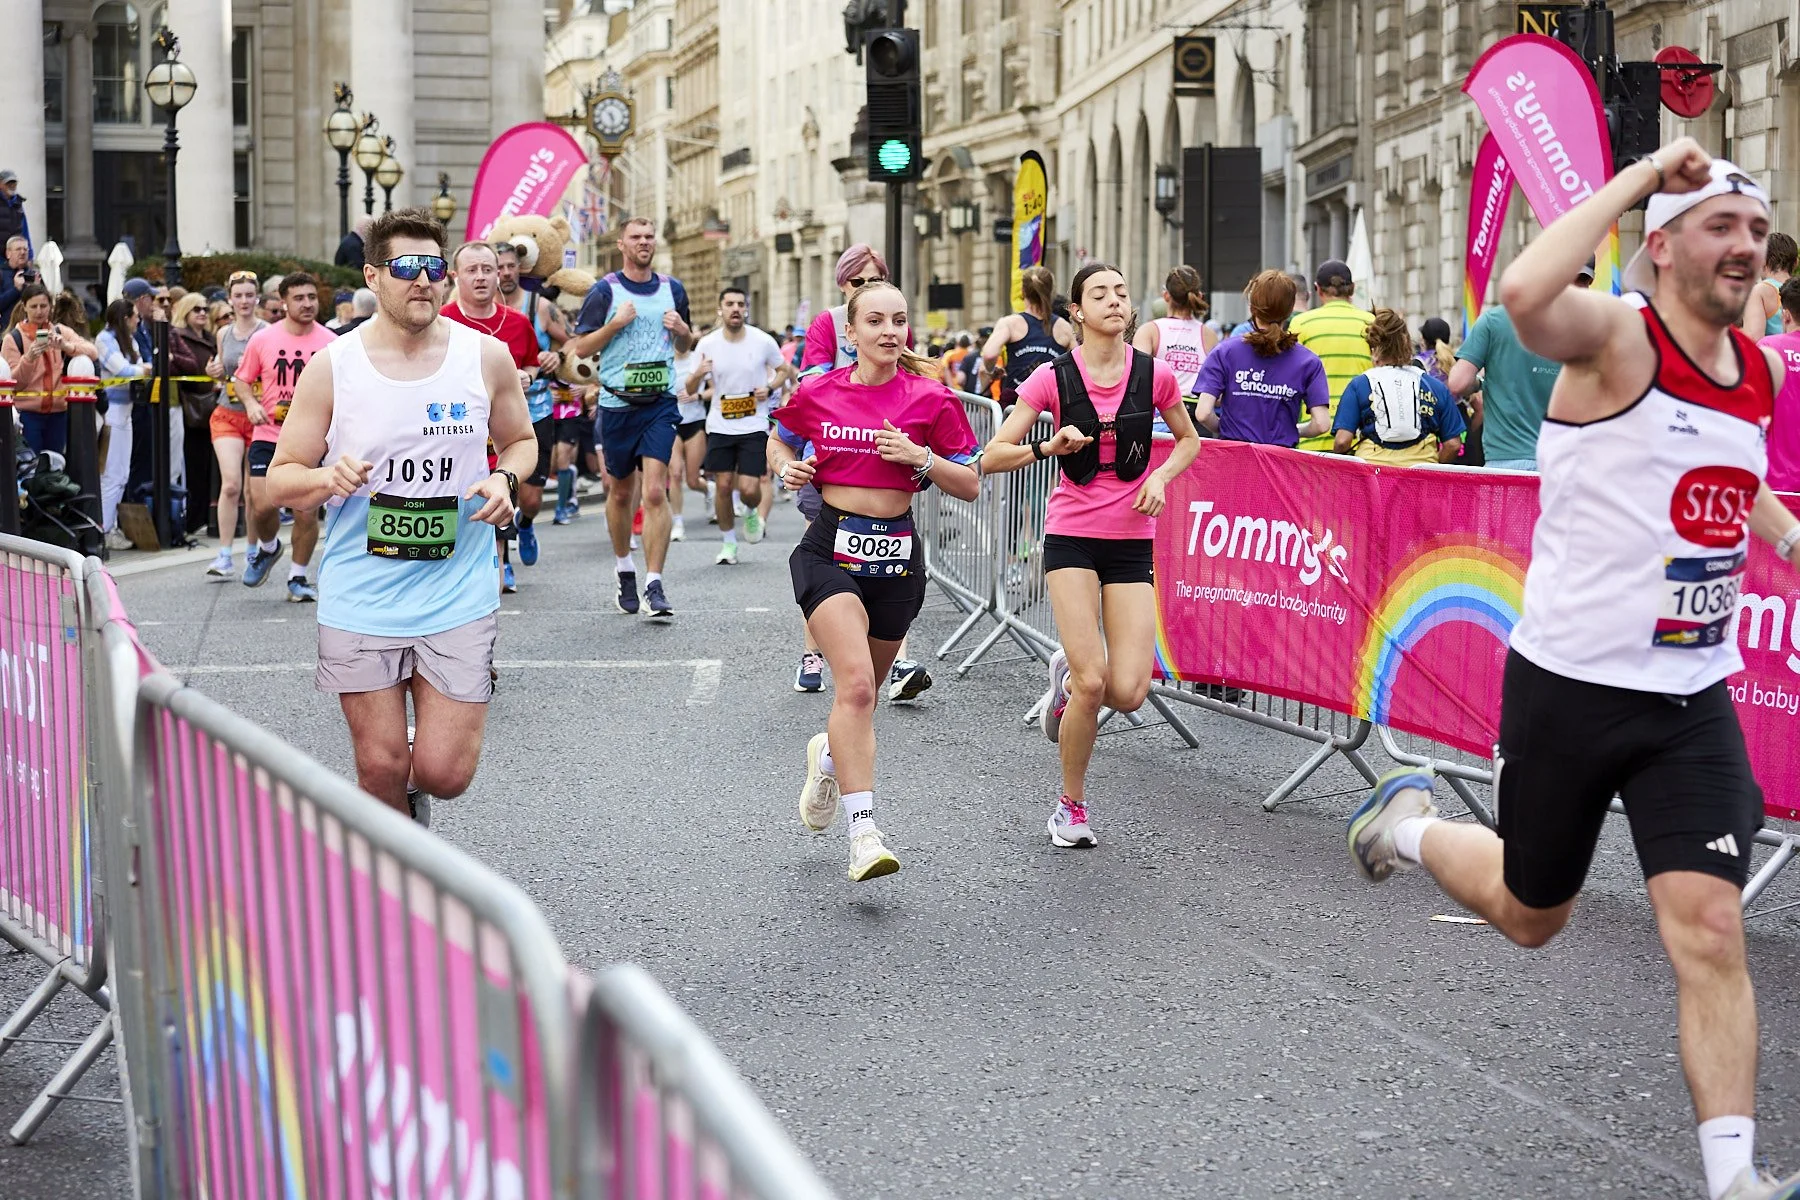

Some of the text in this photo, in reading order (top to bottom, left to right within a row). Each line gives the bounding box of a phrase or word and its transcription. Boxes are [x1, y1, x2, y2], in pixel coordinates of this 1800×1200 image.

[480, 147, 555, 239] mmy's
[1472, 154, 1505, 257] Tommy's
[632, 370, 663, 384] 7090
[1240, 381, 1297, 397] encounter
[423, 425, 474, 436] BATTERSEA
[821, 421, 909, 442] Tomm
[829, 445, 858, 455] pregnancy
[386, 458, 453, 483] JOSH
[403, 501, 425, 509] JOSH
[380, 514, 445, 539] 8505
[871, 523, 888, 532] ELLI
[847, 535, 902, 557] 9082
[1176, 580, 1347, 625] The pregnancy and baby charity
[1673, 579, 1739, 616] 1036
[1727, 680, 1800, 716] nd baby
